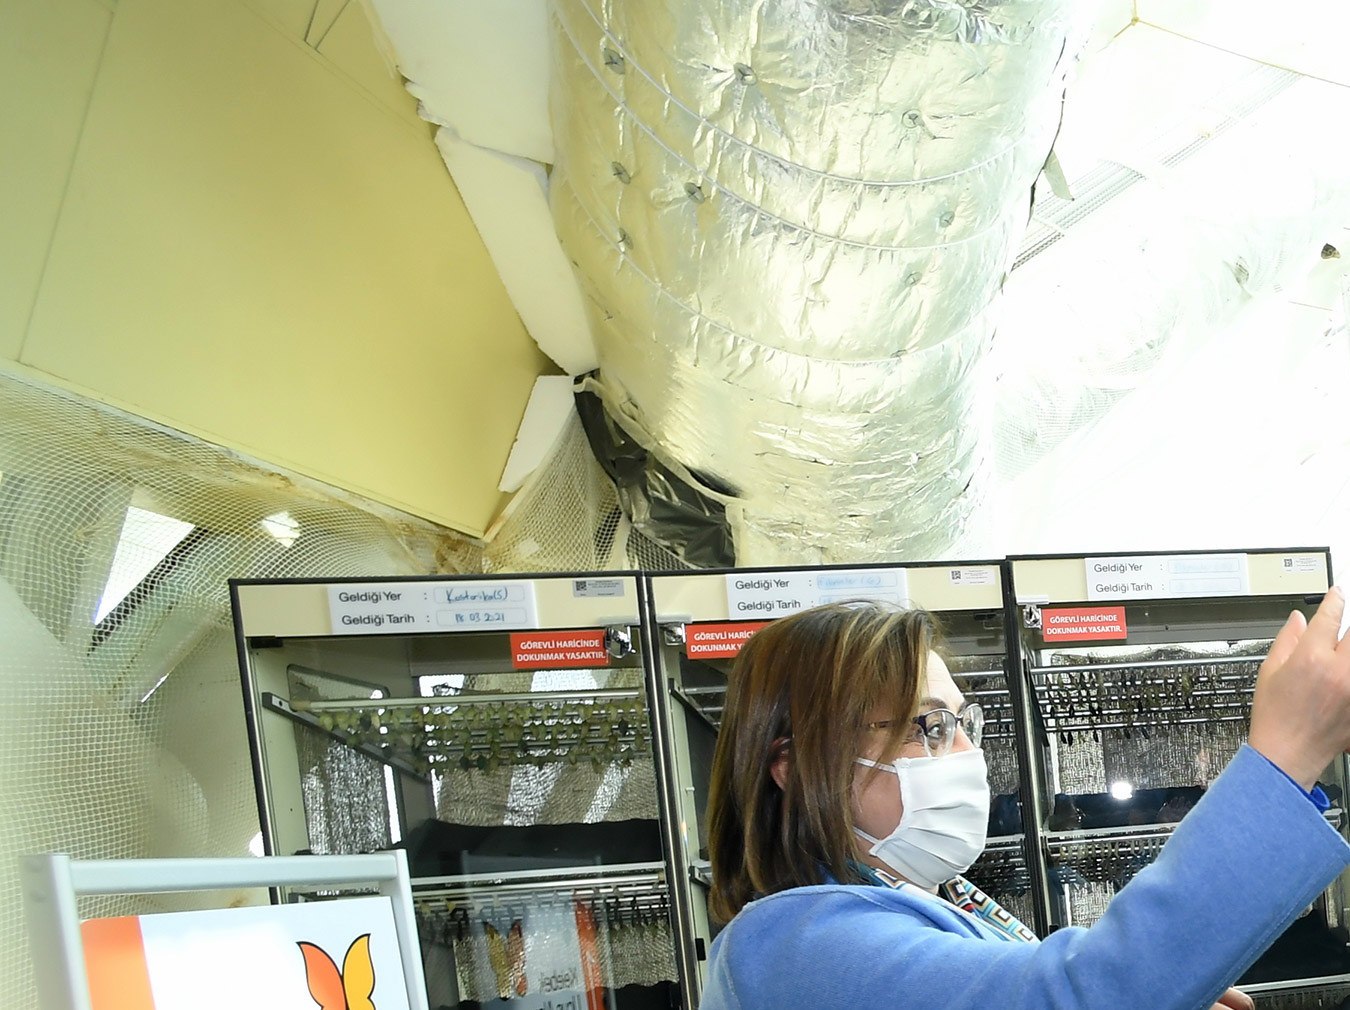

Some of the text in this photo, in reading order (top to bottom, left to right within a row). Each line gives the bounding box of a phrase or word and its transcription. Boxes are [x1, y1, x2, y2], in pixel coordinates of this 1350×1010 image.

[1094, 563, 1143, 573] Geldiği Yer
[735, 579, 790, 590] Geldiği Yer
[1096, 583, 1153, 593] Geldiği Tarih
[338, 591, 402, 604] Geldiği Yer
[737, 600, 801, 611] Geldiği Tarih
[341, 613, 415, 626] Geldiği Tarih
[1049, 614, 1118, 624] GÖREVLİ HARİCİNDE
[694, 631, 727, 641] GÖREVLİ
[1046, 627, 1088, 635] DOKUNMAK
[520, 638, 600, 650] GÖREVLİ HARİCİNDE
[690, 643, 737, 653] DOKUNMAK
[516, 650, 606, 662] DOKUNMAK YASAKTIR.
